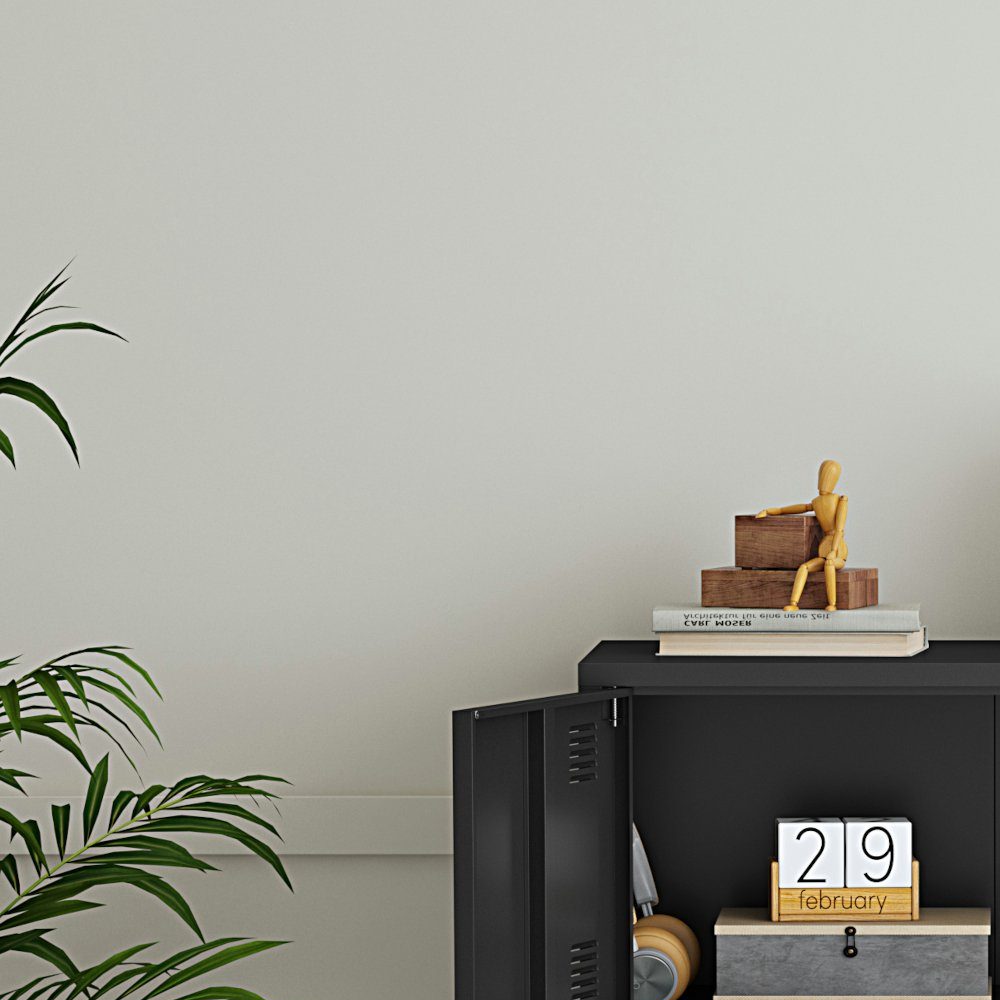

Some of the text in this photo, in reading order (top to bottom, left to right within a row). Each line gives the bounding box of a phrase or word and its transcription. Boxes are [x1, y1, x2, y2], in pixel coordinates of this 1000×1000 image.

[795, 826, 894, 883] 2 9
[798, 890, 887, 914] february
